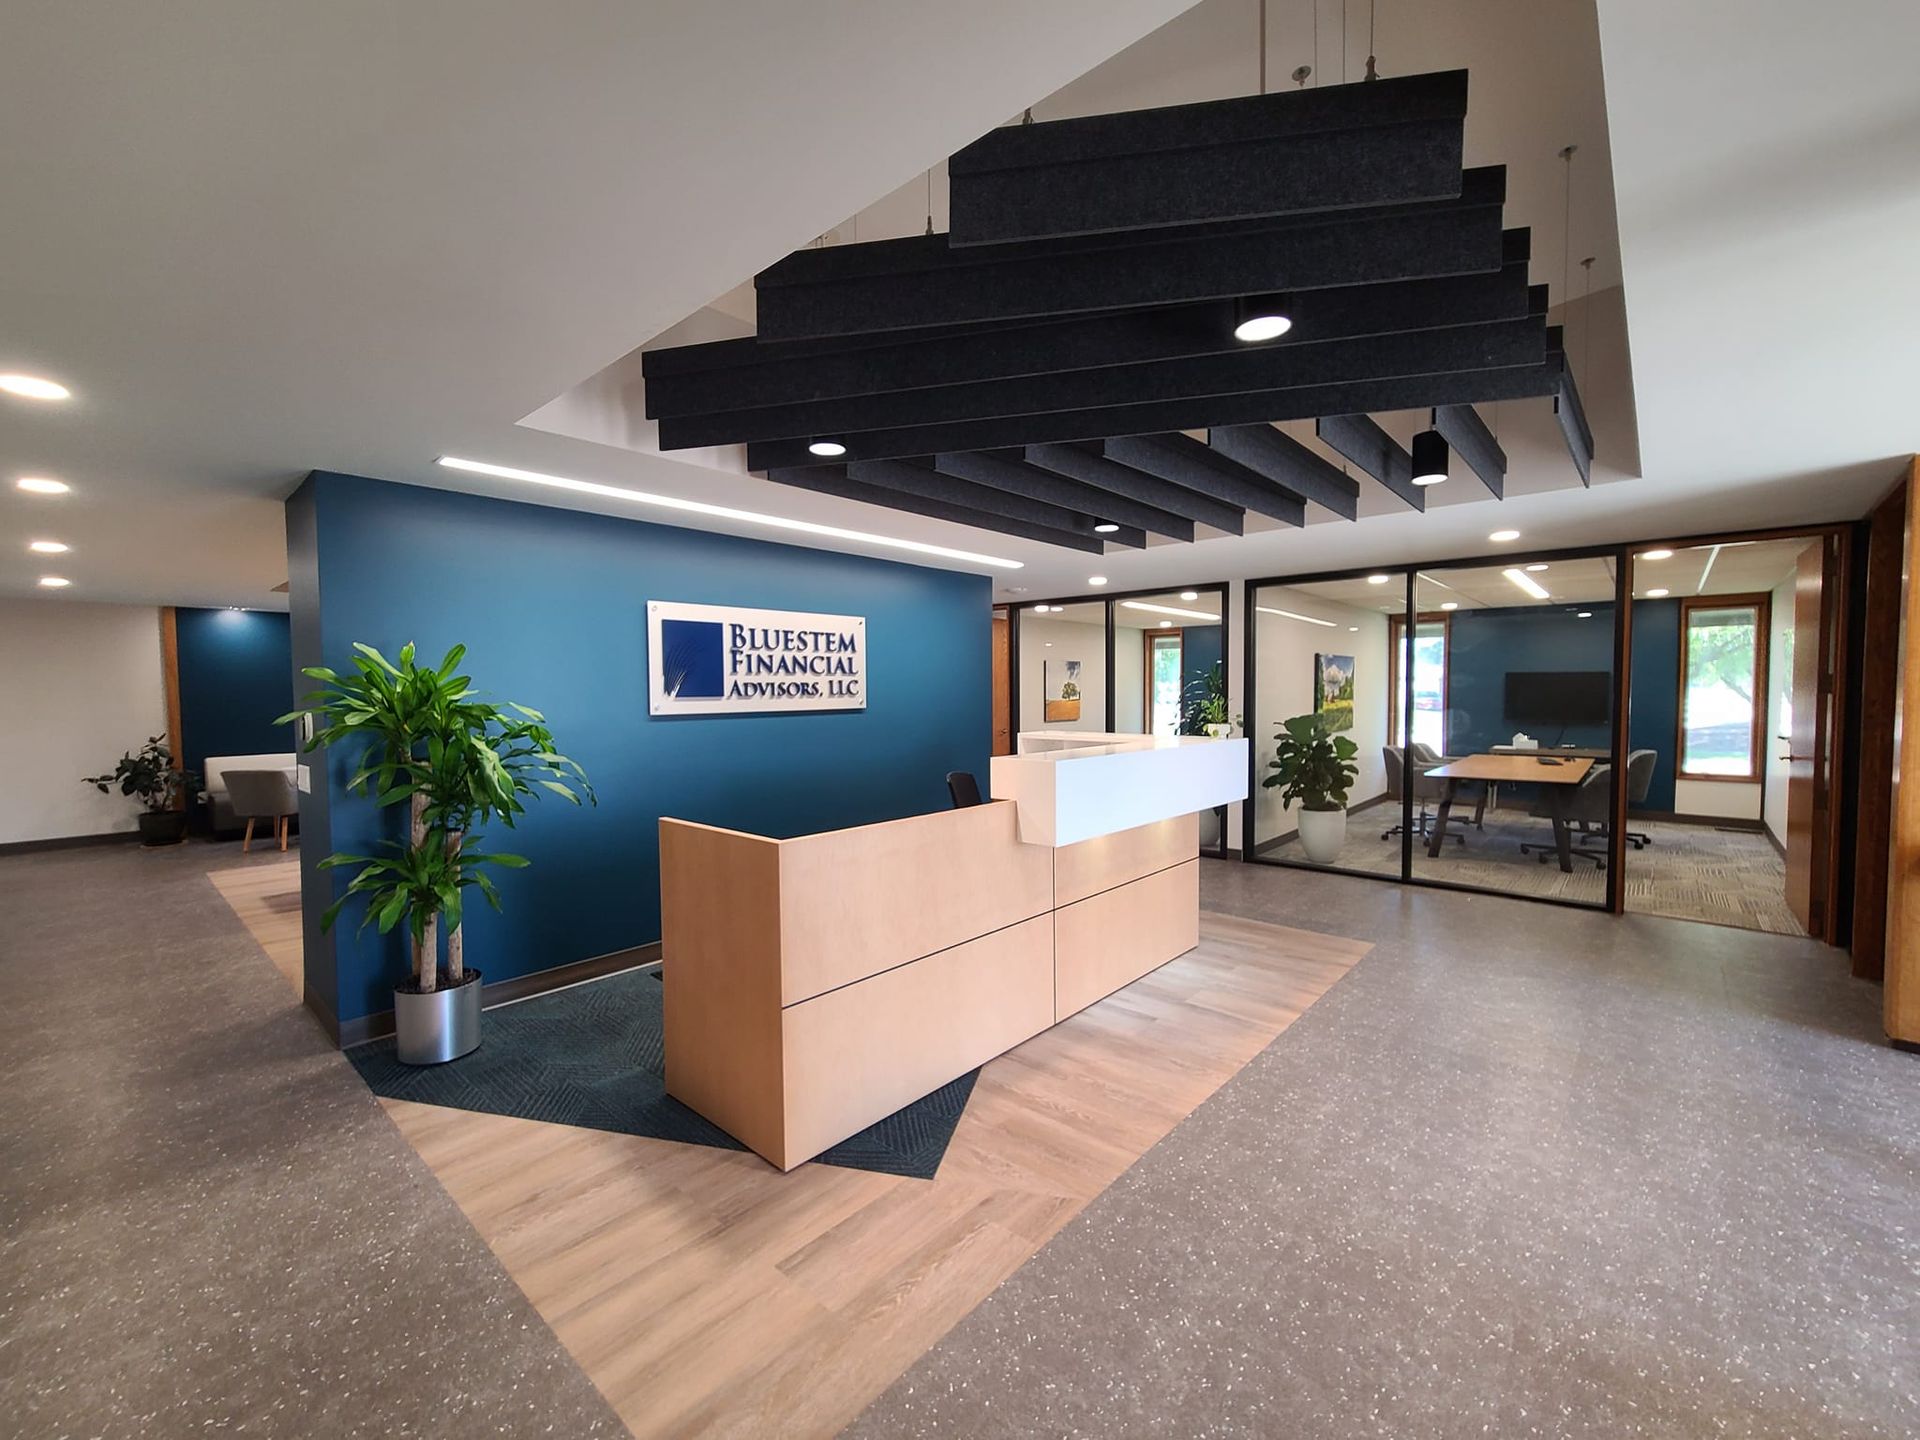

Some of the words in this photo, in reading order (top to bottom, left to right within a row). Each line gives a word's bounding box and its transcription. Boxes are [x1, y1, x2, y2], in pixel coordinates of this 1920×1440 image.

[729, 623, 857, 653] BLUESTEM
[730, 650, 858, 675] FINANCIAL
[729, 680, 823, 697] ADVISORS,
[829, 680, 859, 696] LLC
